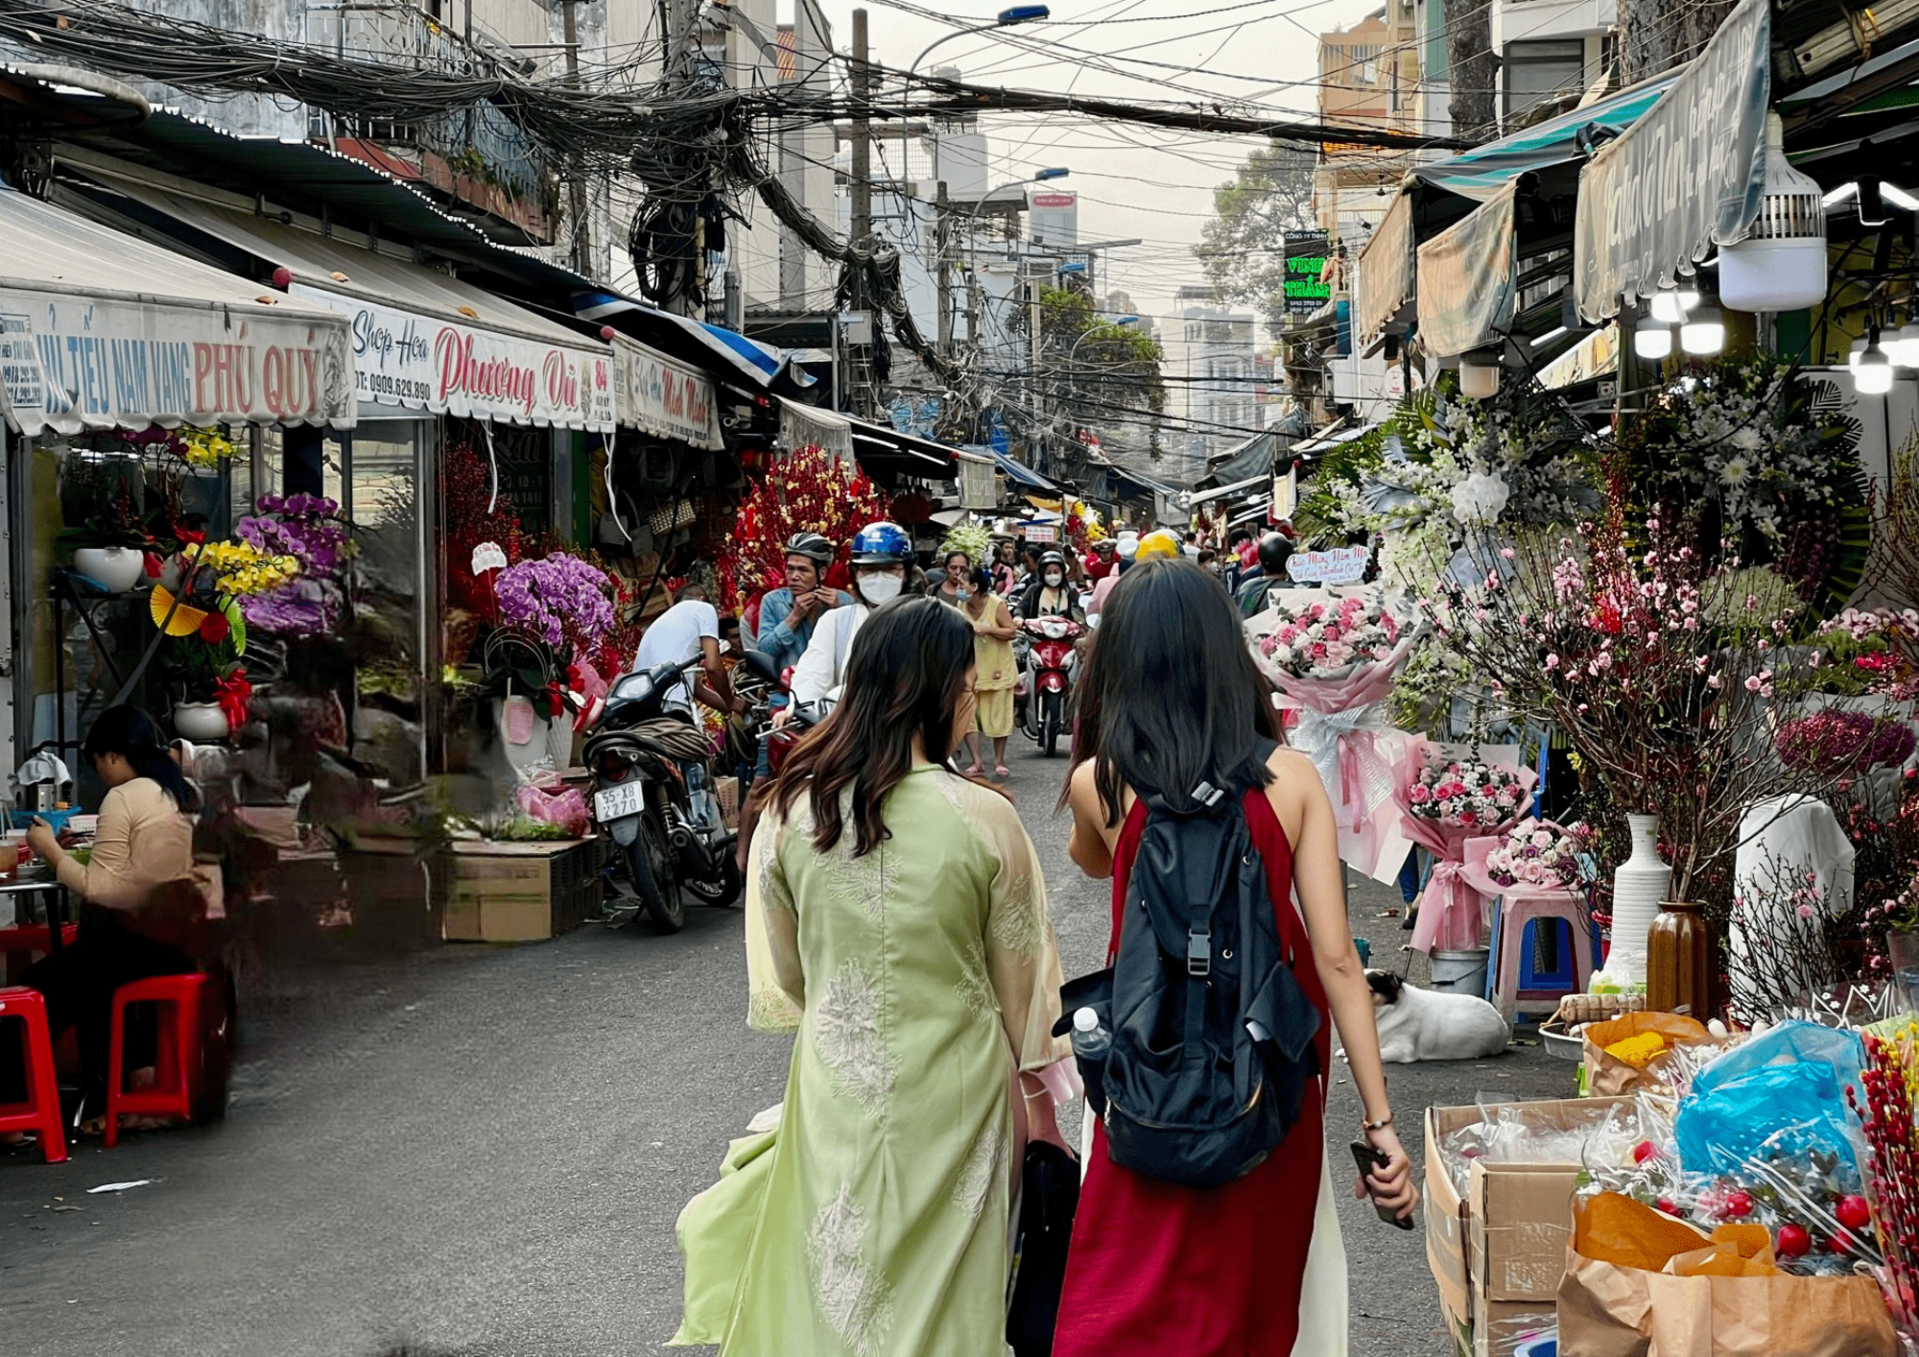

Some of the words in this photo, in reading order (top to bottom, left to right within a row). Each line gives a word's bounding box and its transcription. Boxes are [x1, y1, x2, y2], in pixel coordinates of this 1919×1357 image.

[353, 310, 393, 370] Shop
[396, 319, 429, 367] Hoa
[110, 338, 149, 414] NAM
[149, 341, 192, 414] VANG
[193, 320, 256, 414] PHÚ
[262, 328, 320, 421] QUÝ
[369, 373, 431, 401] 0909.629.890
[434, 326, 536, 417] Phương
[602, 785, 635, 805] 55-X8
[604, 798, 636, 818] 2270
